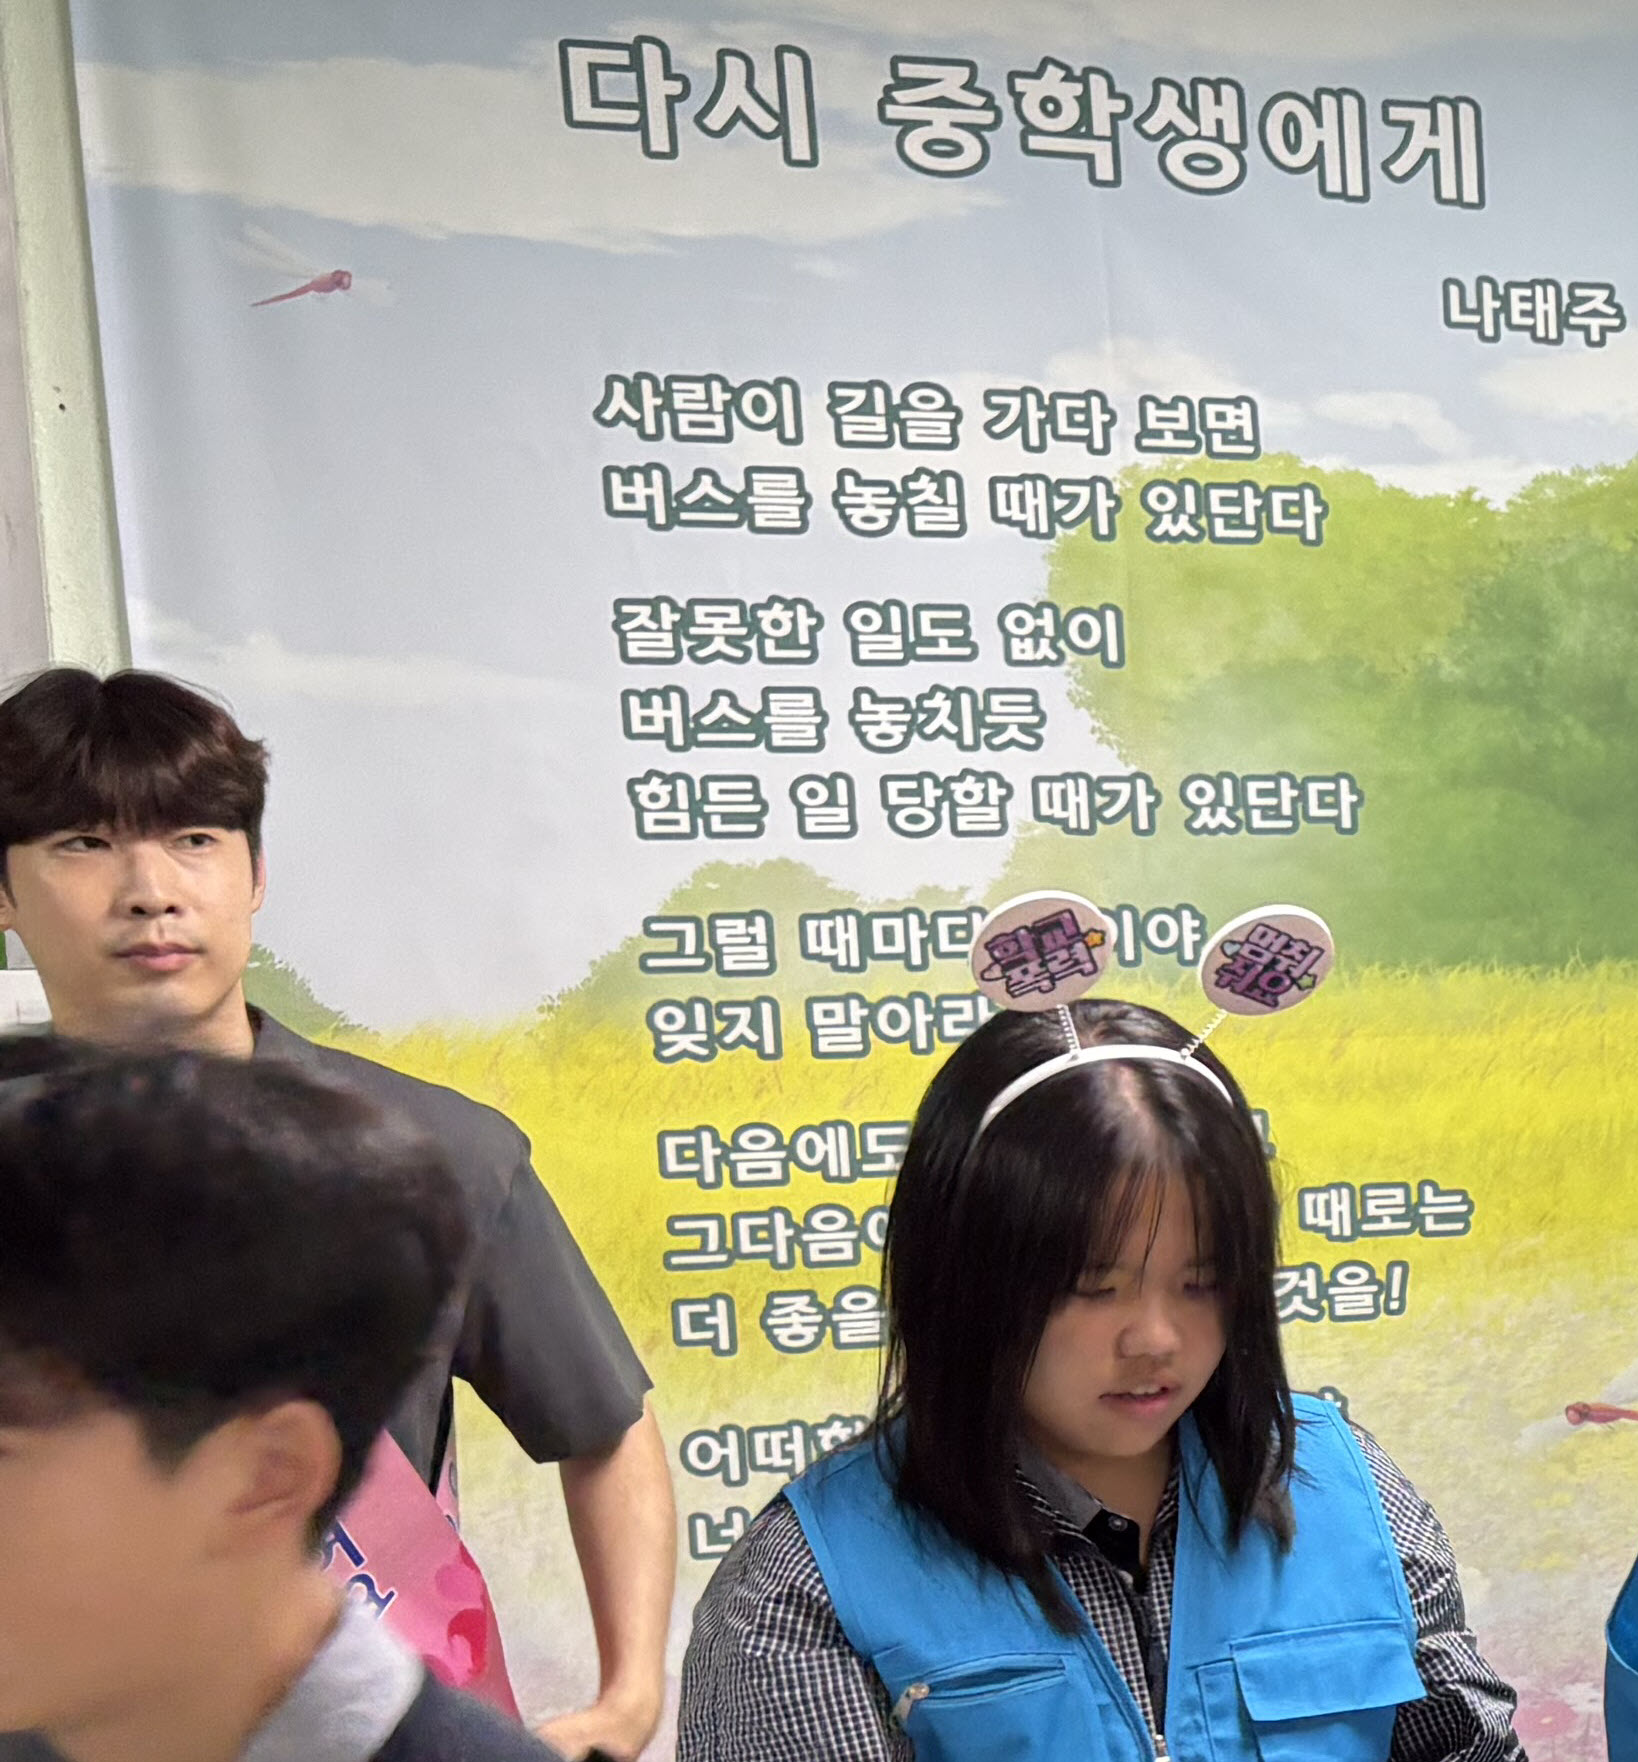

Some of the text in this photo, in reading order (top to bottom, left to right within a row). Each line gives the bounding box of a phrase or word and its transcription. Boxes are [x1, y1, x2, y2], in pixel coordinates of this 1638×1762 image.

[558, 36, 1486, 208] 다시 중학생에게
[1440, 277, 1625, 347] 나태주
[596, 373, 1260, 459] 사람이 길을 가다 보면
[603, 464, 1329, 545] 버스를 놓칠 때가 있단다
[613, 596, 1125, 668] 잘못한 일도 없이
[621, 686, 1046, 752] 버스를 놓치듯
[627, 769, 1363, 839] 힘든 일 당할 때가 있단다
[638, 902, 1207, 974] 그럴 때마다 이야
[1004, 941, 1099, 999] 폭력
[1239, 921, 1326, 980] 멈춰
[646, 991, 1000, 1062] 잊지 말아라
[657, 1118, 913, 1190] 다음에도
[1298, 1178, 1475, 1242] 때로는
[671, 1292, 738, 1358] 더
[1273, 1259, 1410, 1323] 것을!
